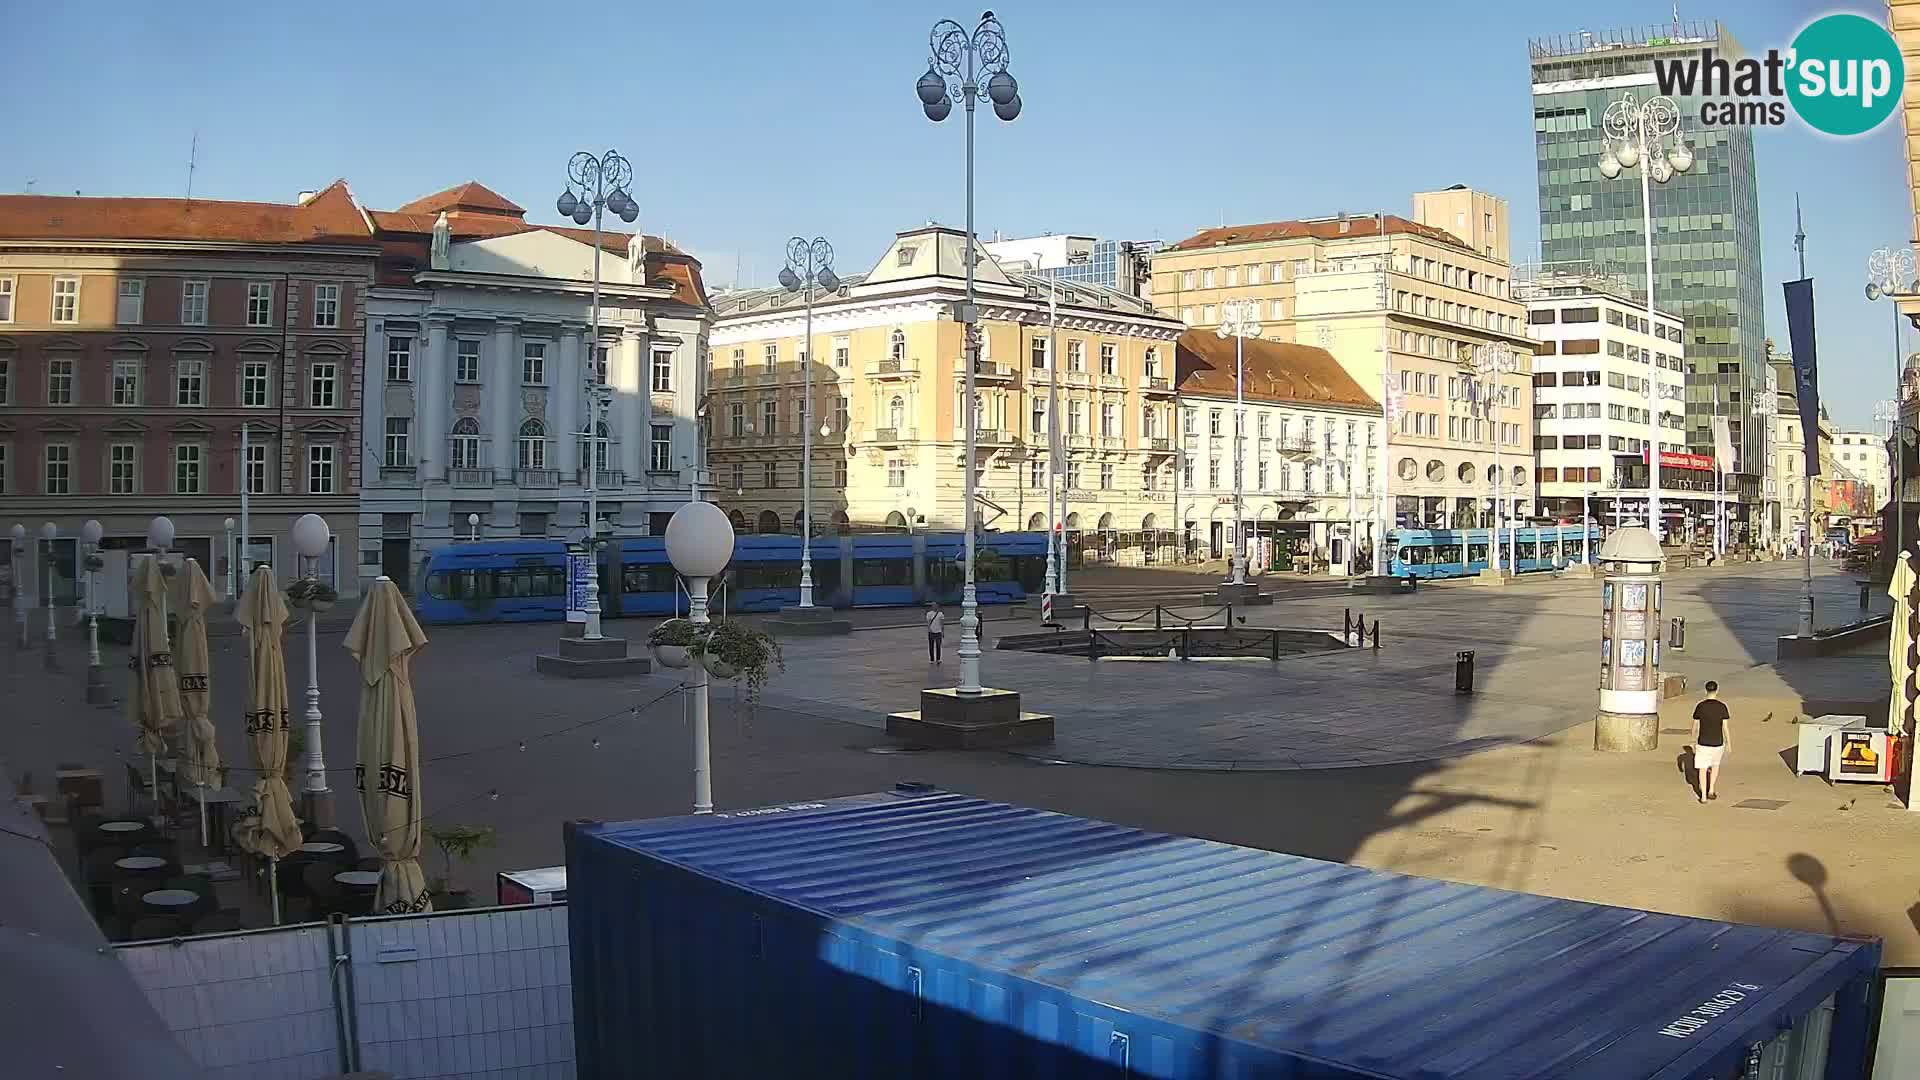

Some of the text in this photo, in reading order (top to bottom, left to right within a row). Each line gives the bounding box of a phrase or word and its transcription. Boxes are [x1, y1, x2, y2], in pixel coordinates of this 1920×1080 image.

[1657, 983, 1759, 1039] MCDU 300629 6
